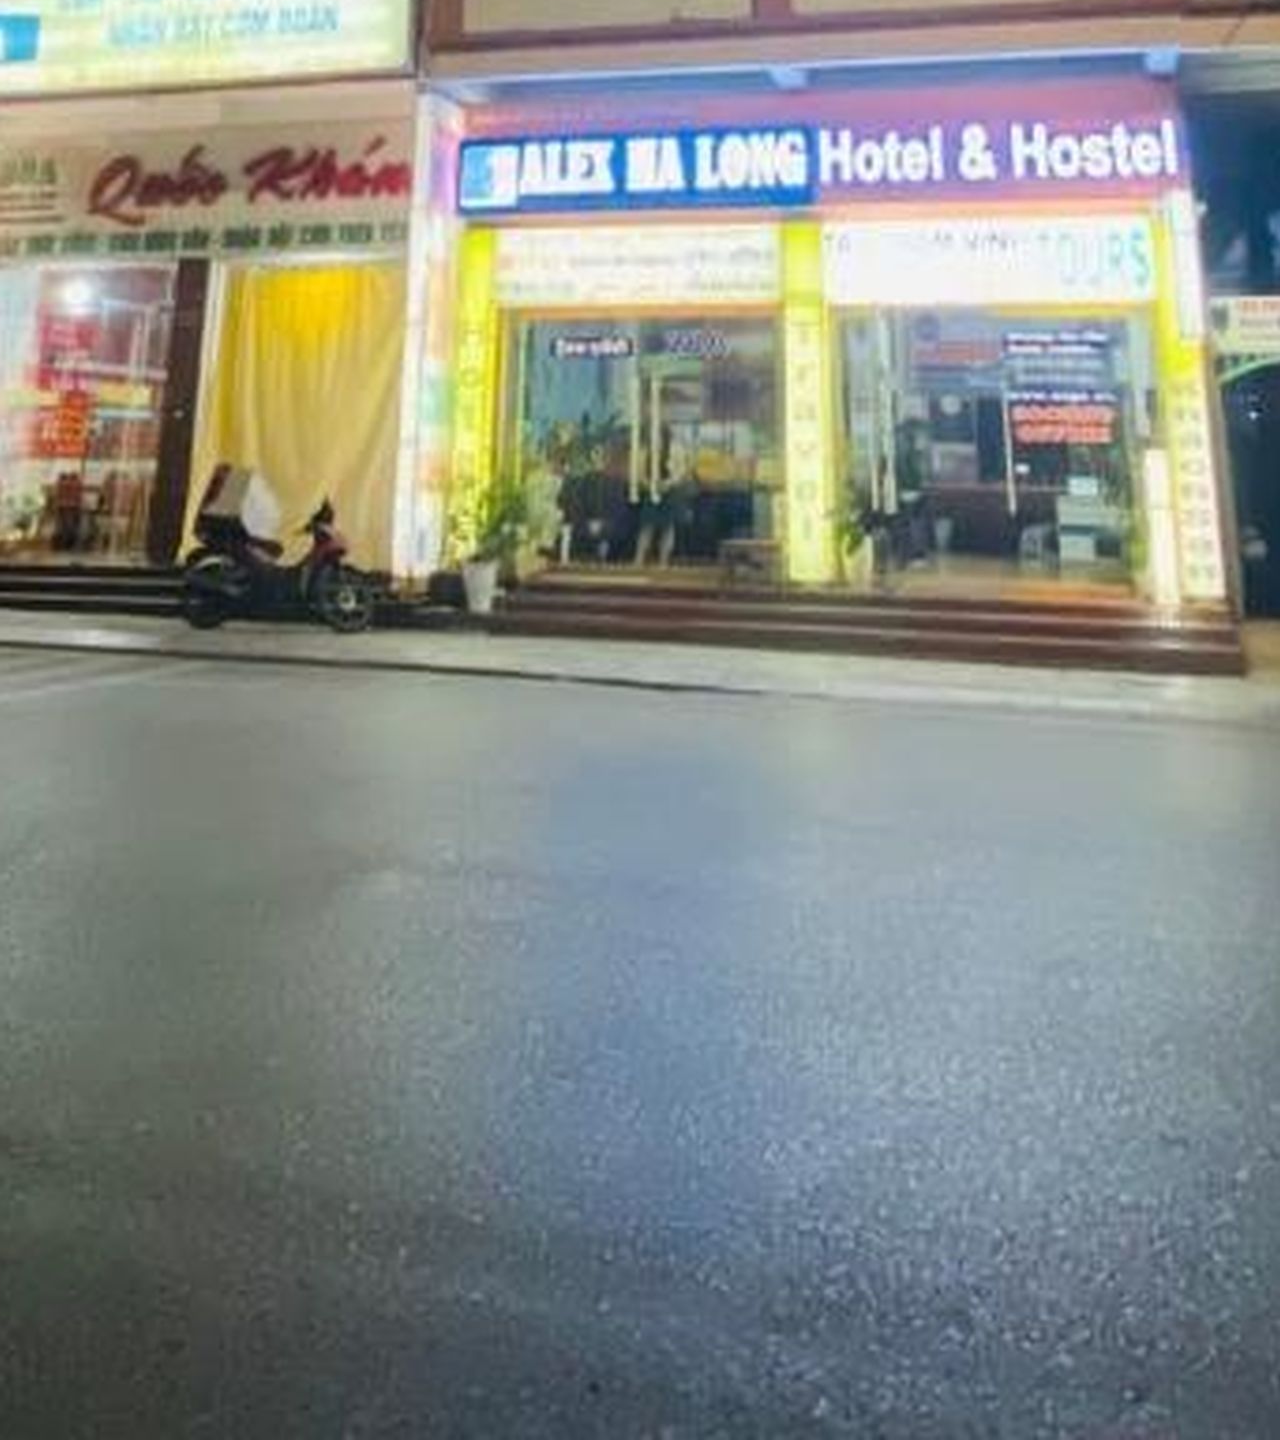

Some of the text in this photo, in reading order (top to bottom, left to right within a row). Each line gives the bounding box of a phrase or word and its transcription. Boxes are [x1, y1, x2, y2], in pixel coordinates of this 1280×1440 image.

[242, 135, 412, 205] Khán
[520, 140, 614, 194] ALEX
[694, 129, 806, 187] LONG
[820, 126, 943, 182] Hotel
[958, 123, 996, 179] &
[1010, 118, 1178, 178] Hostel
